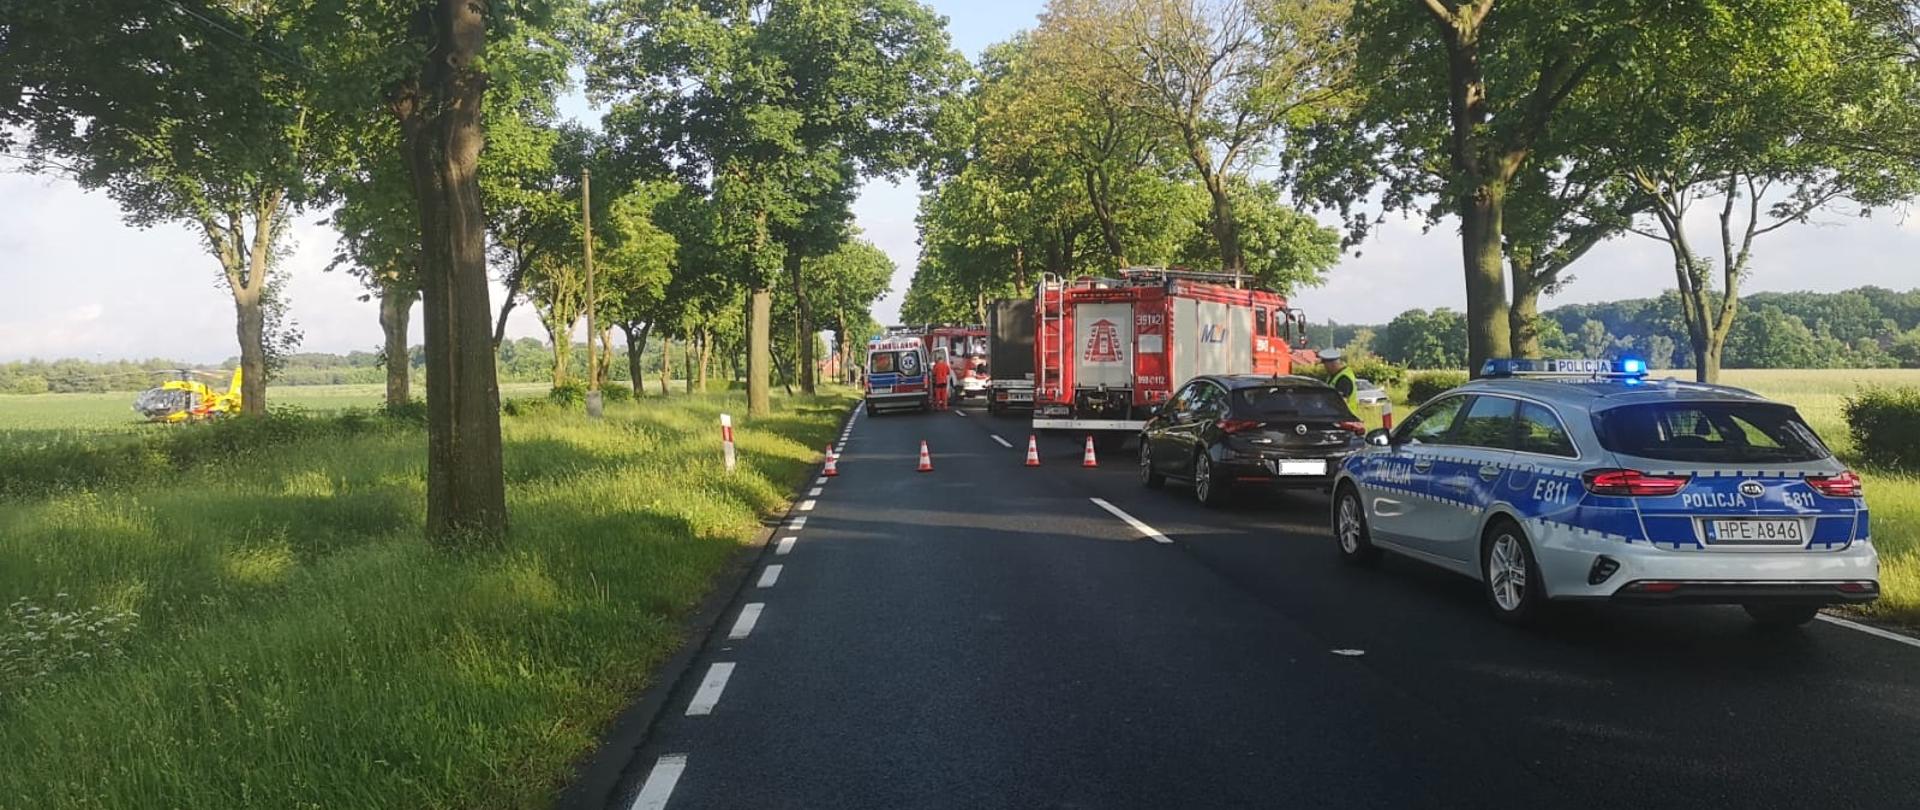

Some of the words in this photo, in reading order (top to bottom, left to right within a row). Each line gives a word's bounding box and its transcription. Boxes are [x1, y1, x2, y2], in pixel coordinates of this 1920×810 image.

[1559, 360, 1610, 372] POLICJA
[1376, 461, 1412, 485] POLICJA
[1533, 478, 1569, 505] E811
[1682, 493, 1746, 508] POLICJA
[1783, 492, 1816, 507] E811
[1718, 522, 1751, 540] HPE
[1757, 521, 1797, 540] A846
